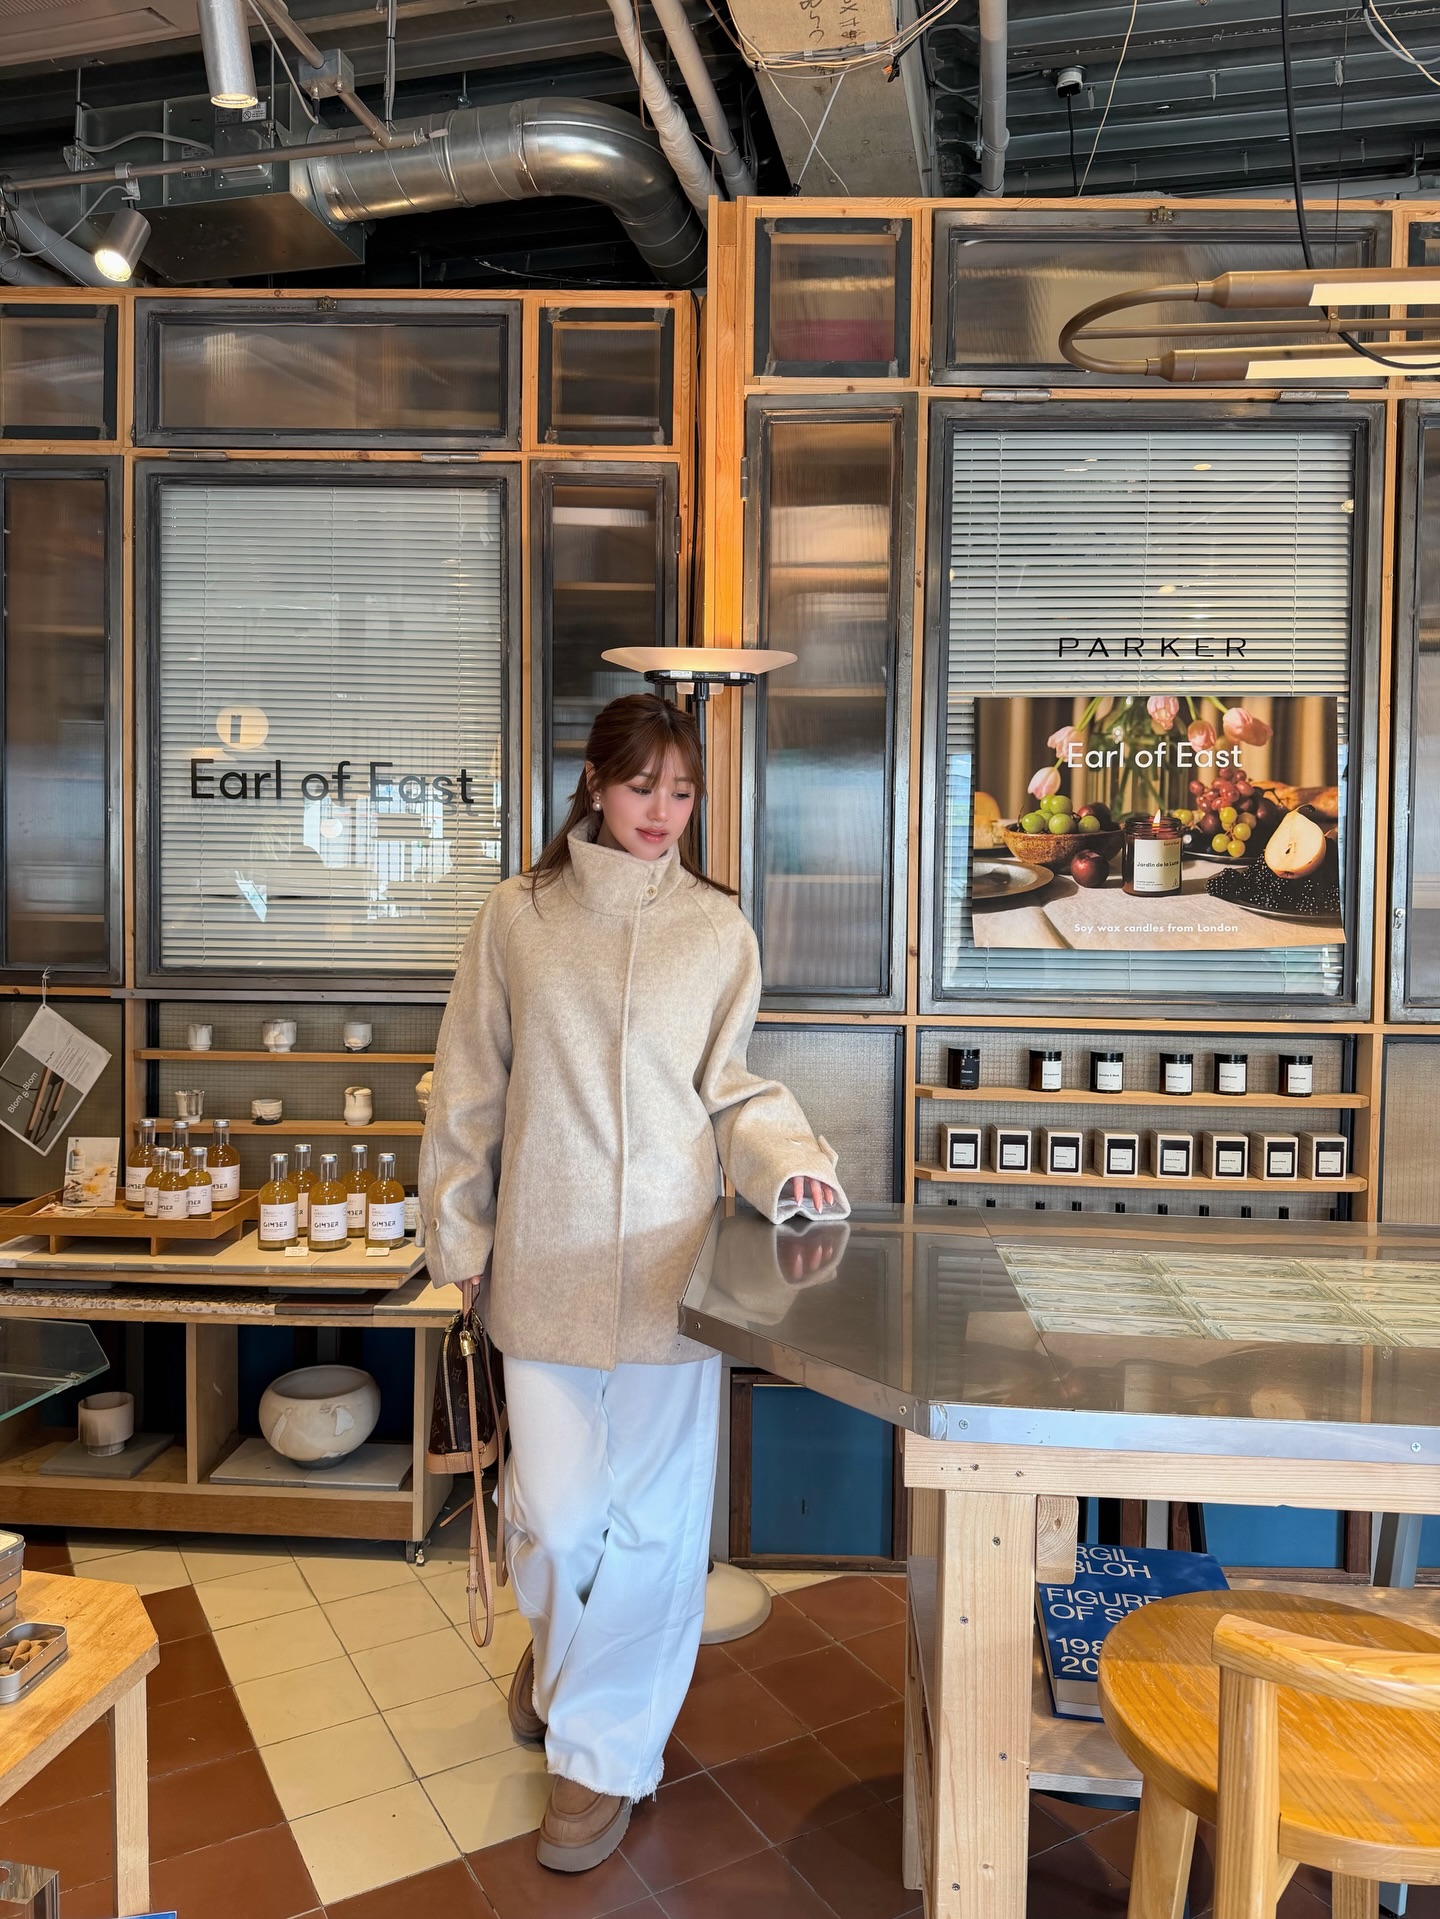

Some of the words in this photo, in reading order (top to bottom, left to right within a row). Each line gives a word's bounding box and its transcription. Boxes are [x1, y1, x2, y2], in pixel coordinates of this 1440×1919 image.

[1058, 637, 1247, 657] PARKER
[1067, 742, 1124, 768] Earl
[1134, 742, 1167, 768] of
[1177, 742, 1243, 768] East
[190, 758, 282, 800] Earl
[301, 760, 351, 801] of
[369, 761, 475, 804] East
[1074, 923, 1093, 934] Soy
[1124, 923, 1164, 932] candles
[1167, 923, 1194, 932] from
[1197, 923, 1239, 932] London
[7, 1094, 23, 1114] Blom
[22, 1071, 39, 1091] Blom
[1076, 1545, 1139, 1563] RGIL
[1075, 1560, 1152, 1579] BLOH
[1049, 1603, 1095, 1621] OF
[1055, 1637, 1104, 1656] 198
[1060, 1655, 1099, 1675] 20
